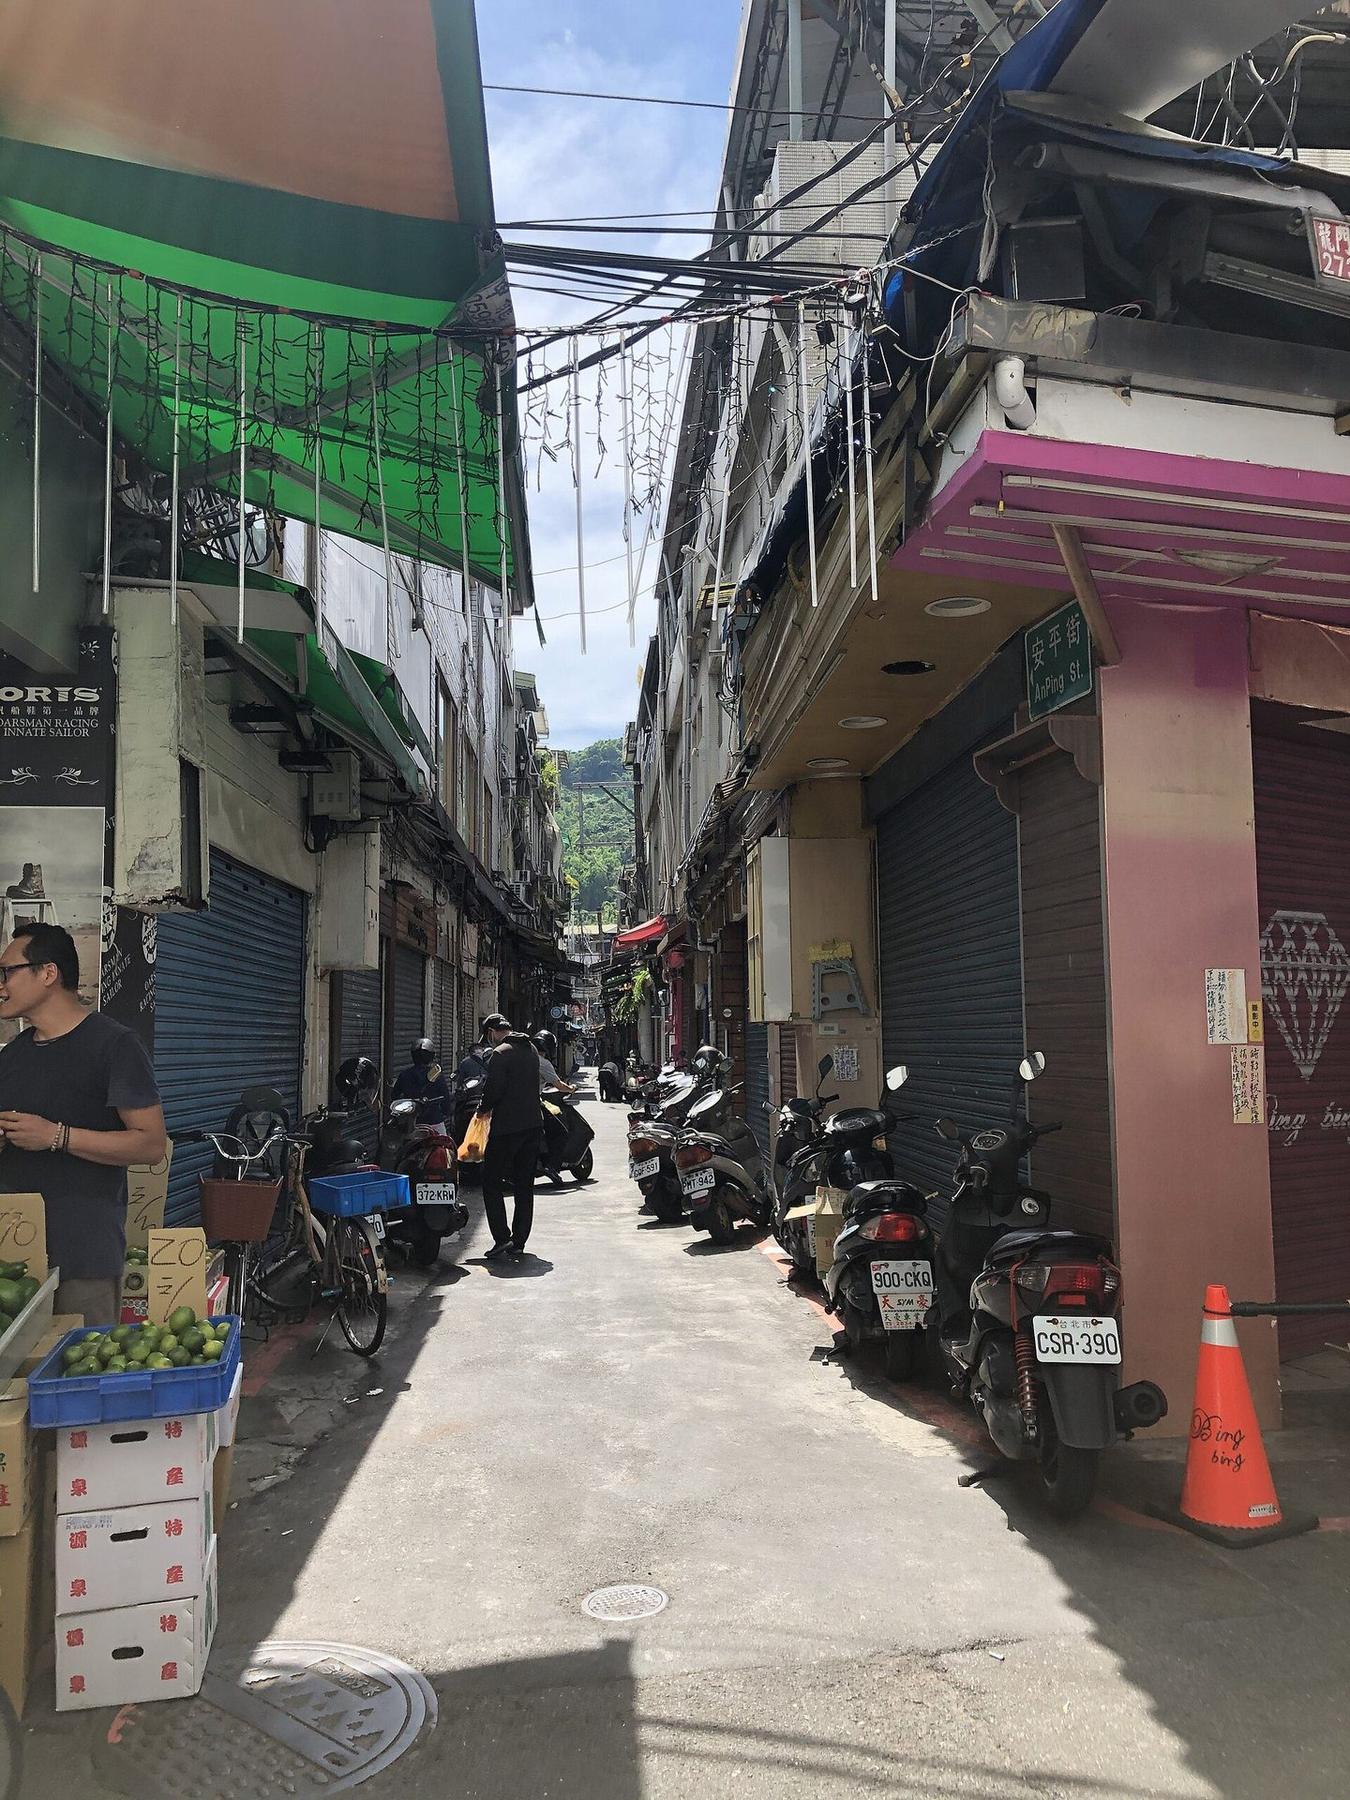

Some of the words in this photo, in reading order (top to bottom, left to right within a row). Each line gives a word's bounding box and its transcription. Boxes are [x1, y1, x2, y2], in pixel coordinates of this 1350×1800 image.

[1319, 222, 1350, 255] 龍門
[1032, 613, 1080, 671] 安平街
[1034, 675, 1065, 703] AnPing
[1069, 660, 1083, 682] St.
[4, 727, 46, 737] INNATE
[49, 728, 90, 737] SAILOR
[55, 719, 99, 728] RACING
[874, 1271, 931, 1288] 900-CKQ
[897, 1298, 914, 1306] SYM
[1037, 1332, 1118, 1355] CSR-390
